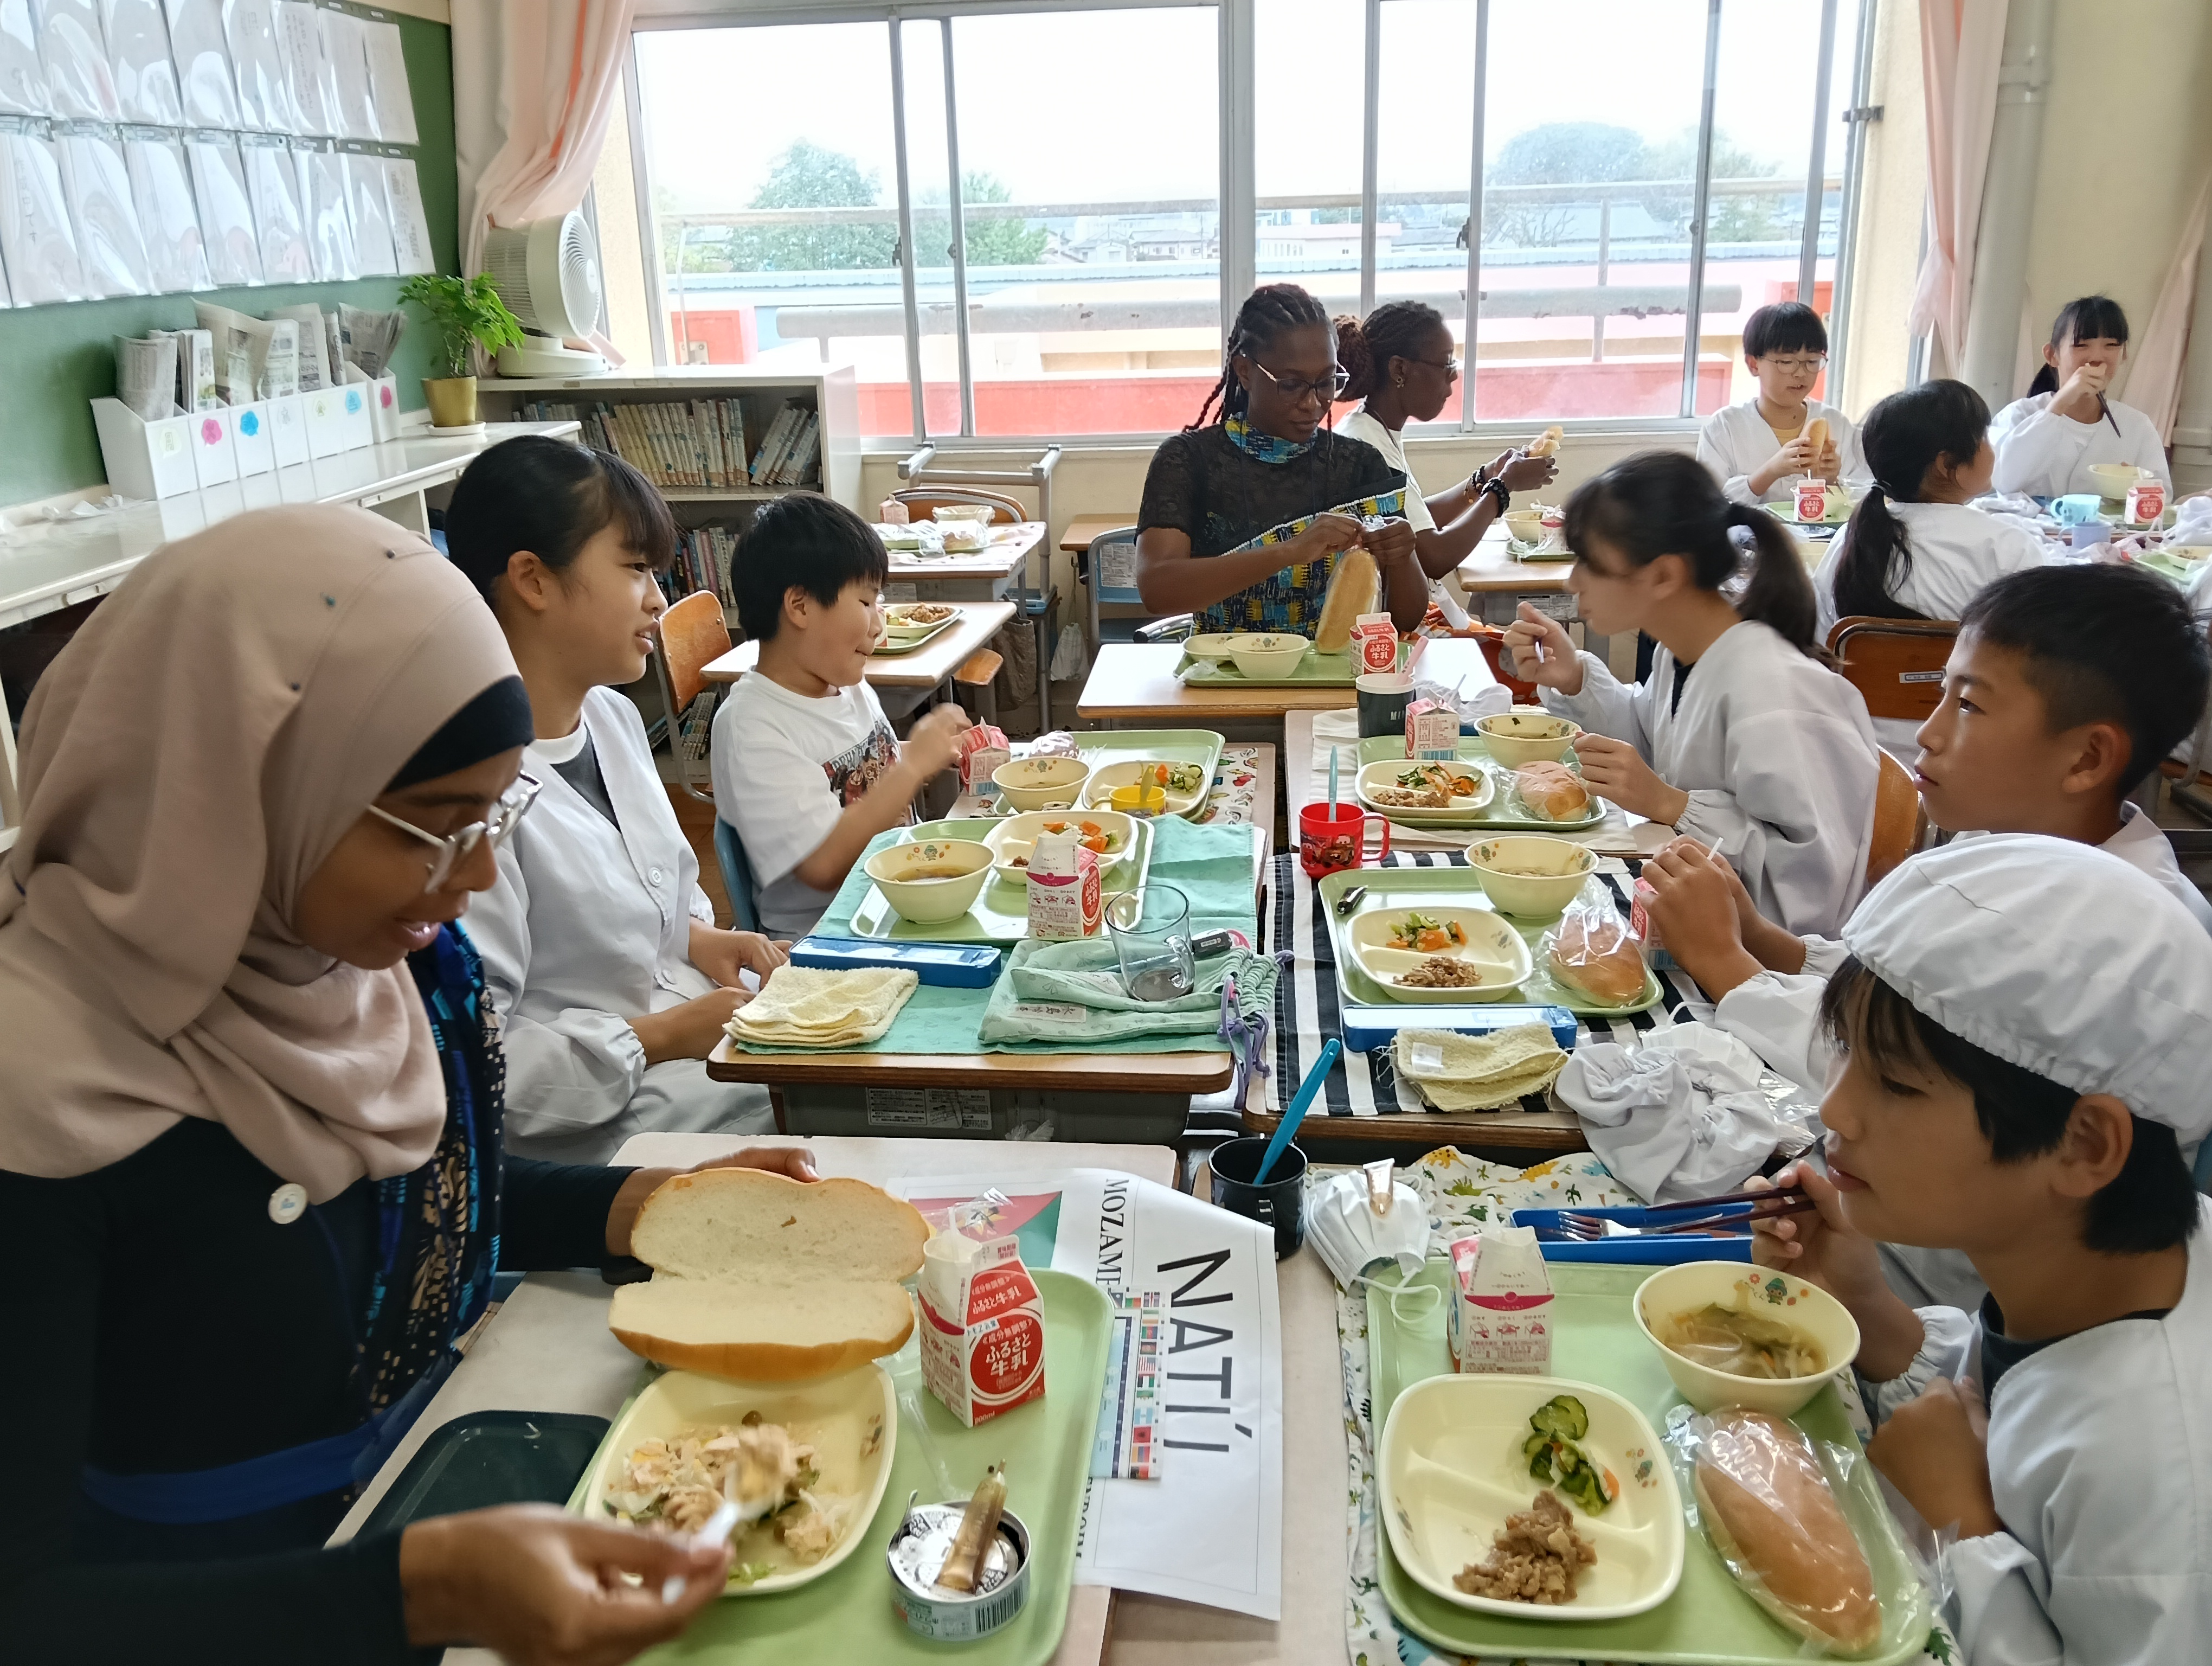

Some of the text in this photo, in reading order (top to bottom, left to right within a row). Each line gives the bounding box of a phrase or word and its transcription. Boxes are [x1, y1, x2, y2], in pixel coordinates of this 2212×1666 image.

[1369, 644, 1390, 652] ふるさと
[973, 1285, 1021, 1314] ふるさと牛乳
[986, 1332, 1031, 1363] ふるさと
[990, 1349, 1028, 1376] 牛乳
